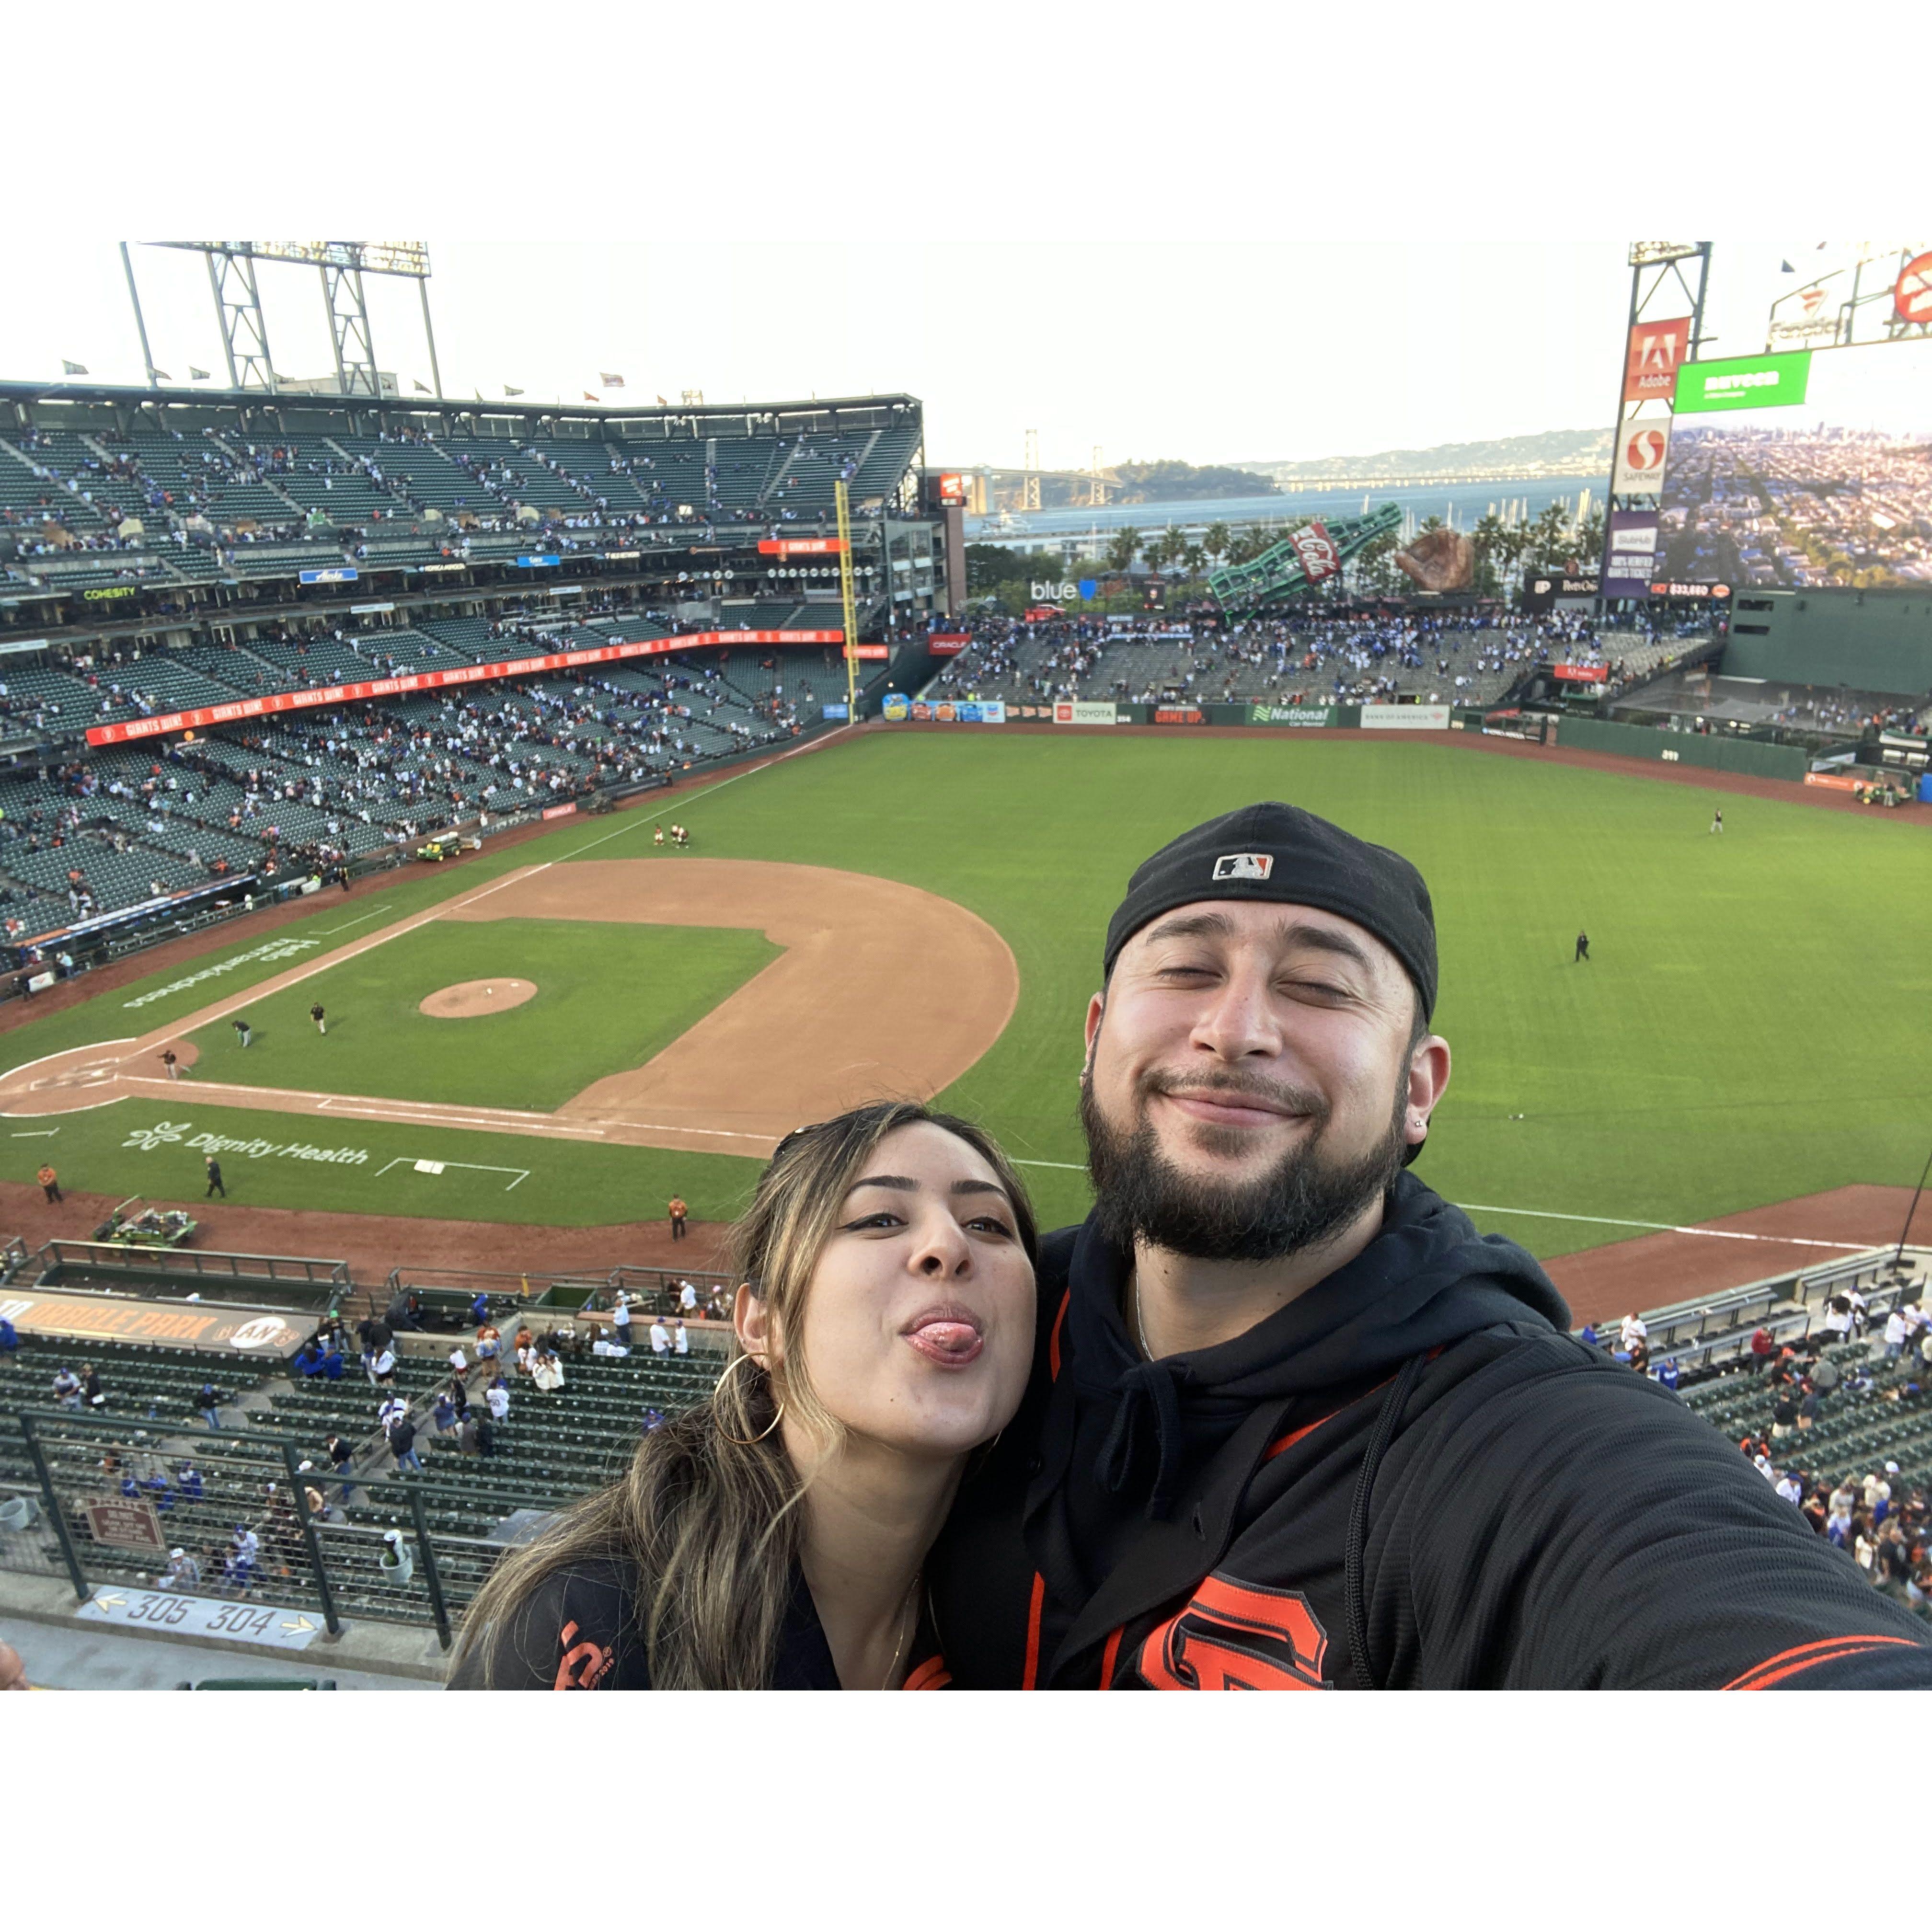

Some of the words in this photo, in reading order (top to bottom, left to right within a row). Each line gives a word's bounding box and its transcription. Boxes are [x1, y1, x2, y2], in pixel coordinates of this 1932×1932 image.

[1638, 374, 1671, 389] Adobe
[84, 586, 135, 600] COHESITY
[1031, 580, 1077, 600] blue
[371, 680, 399, 694] GIANTS
[400, 677, 418, 689] WIN!
[443, 670, 468, 683] GIANTS
[293, 691, 323, 705] GIANTS
[323, 687, 344, 702] WIN!
[213, 704, 242, 719] GIANTS
[243, 700, 264, 714] WIN!
[1076, 709, 1112, 718] TOYOTA
[1271, 707, 1329, 721] National
[125, 719, 160, 736] GIANTS
[161, 714, 183, 731] WIN!
[184, 1132, 283, 1159] Dignity
[277, 1142, 368, 1165] Health
[20, 1302, 139, 1331] ORACLE
[123, 1311, 218, 1340] PARK
[128, 1594, 197, 1624] 305
[206, 1605, 277, 1636] 304
